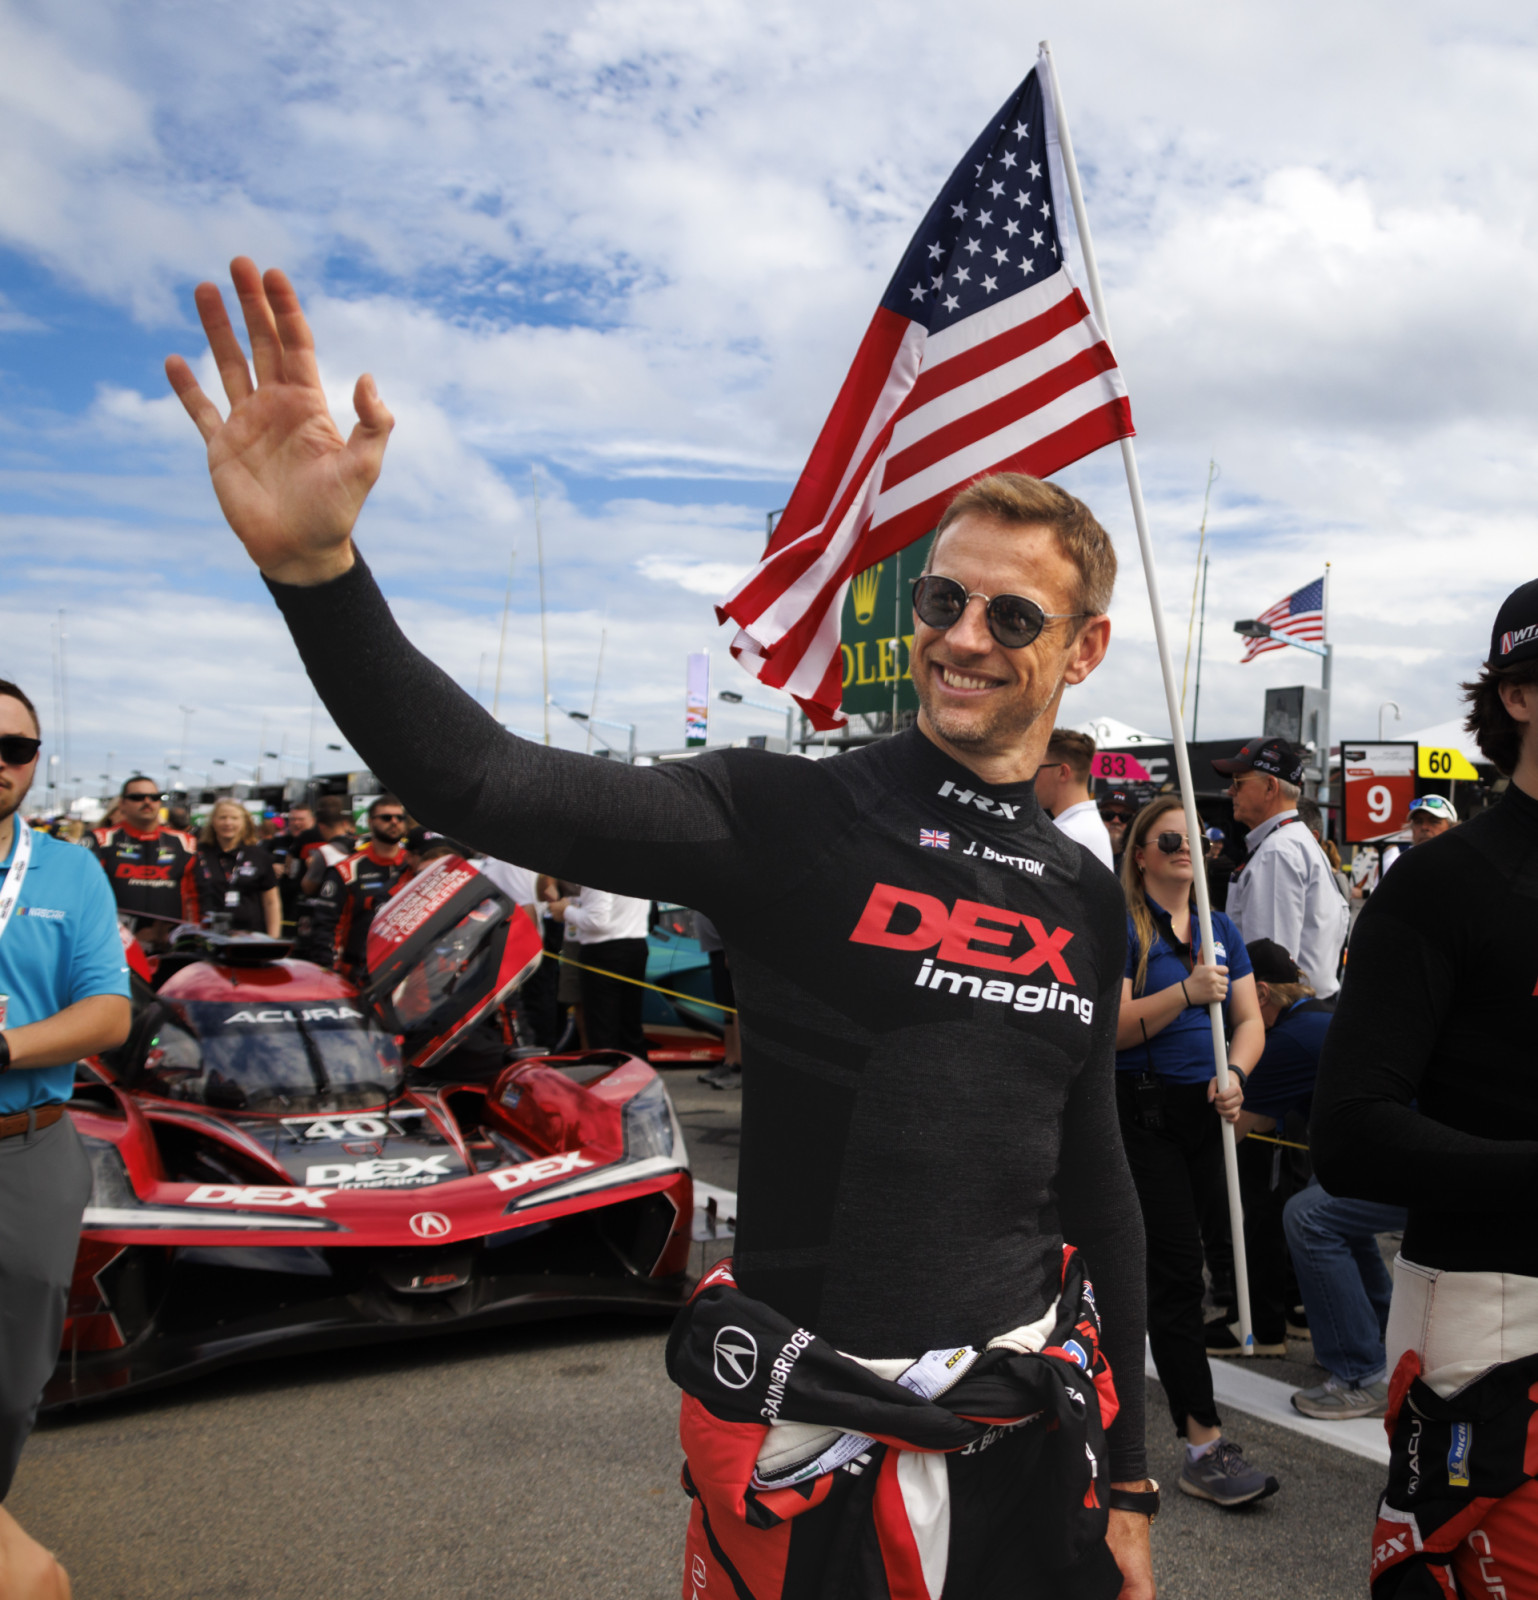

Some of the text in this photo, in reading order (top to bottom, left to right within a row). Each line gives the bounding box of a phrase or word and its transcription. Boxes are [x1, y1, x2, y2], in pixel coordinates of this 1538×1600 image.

[1514, 624, 1538, 642] WT
[1101, 755, 1126, 777] 83
[1429, 751, 1451, 773] 60
[937, 780, 1021, 820] HRX
[1367, 785, 1392, 823] 9
[114, 863, 174, 879] DEX
[962, 841, 1045, 876] J. BUTTON
[401, 871, 472, 935] LOUIS DELETRAZ
[848, 882, 1077, 986] DEX
[914, 957, 1094, 1025] imaging
[223, 1006, 364, 1024] ACURA
[304, 1117, 389, 1140] 40
[305, 1154, 452, 1186] DEX
[488, 1151, 595, 1191] DEX
[185, 1185, 338, 1208] DEX
[760, 1328, 816, 1419] GAINBRIDGE
[1407, 1417, 1423, 1476] ACU
